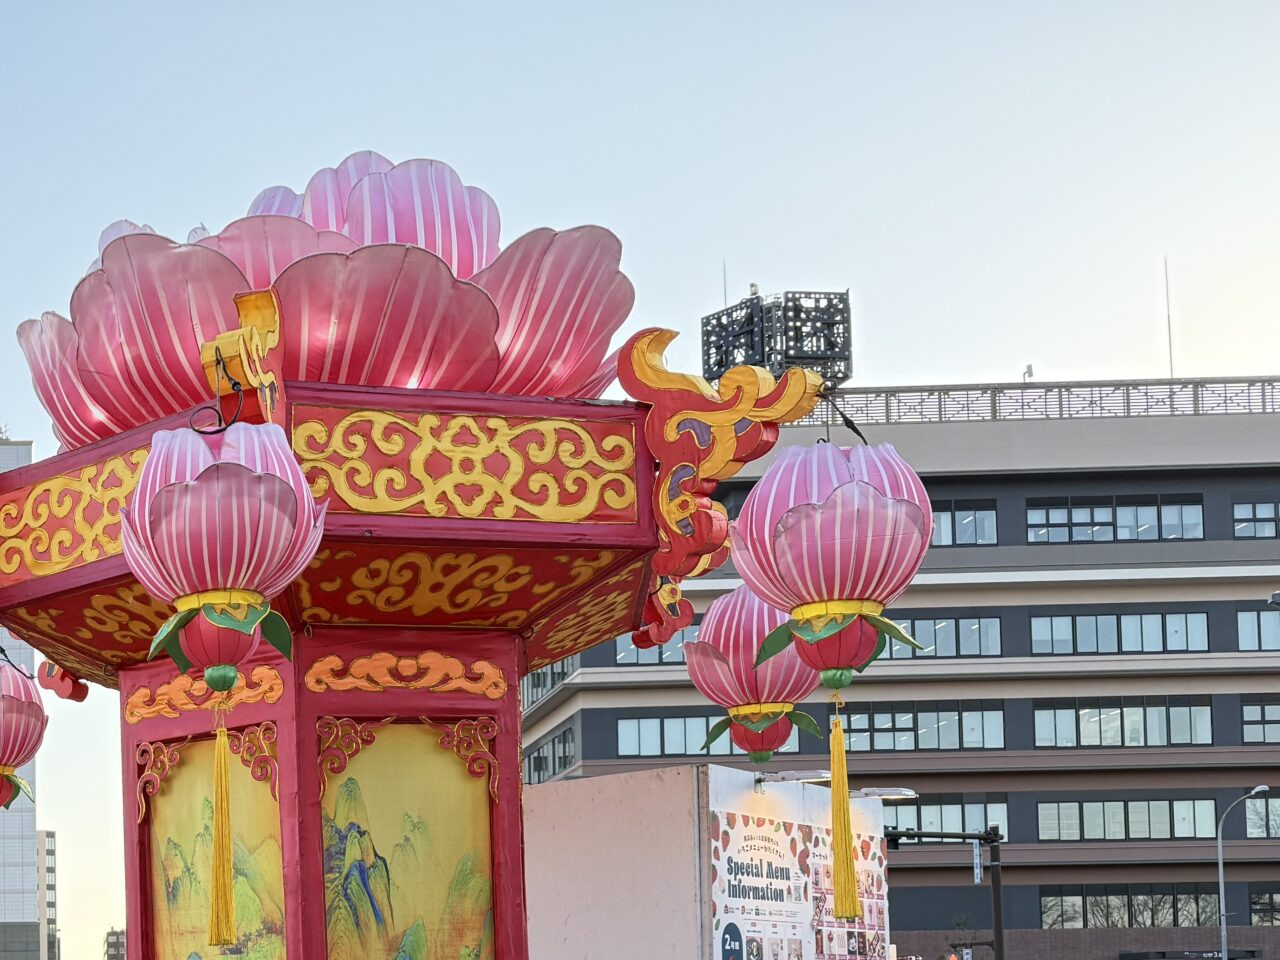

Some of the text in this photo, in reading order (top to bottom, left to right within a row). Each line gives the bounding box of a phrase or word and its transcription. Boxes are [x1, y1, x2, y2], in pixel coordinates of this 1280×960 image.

[727, 856, 764, 881] Special
[766, 860, 791, 881] Menu
[727, 878, 785, 903] Information
